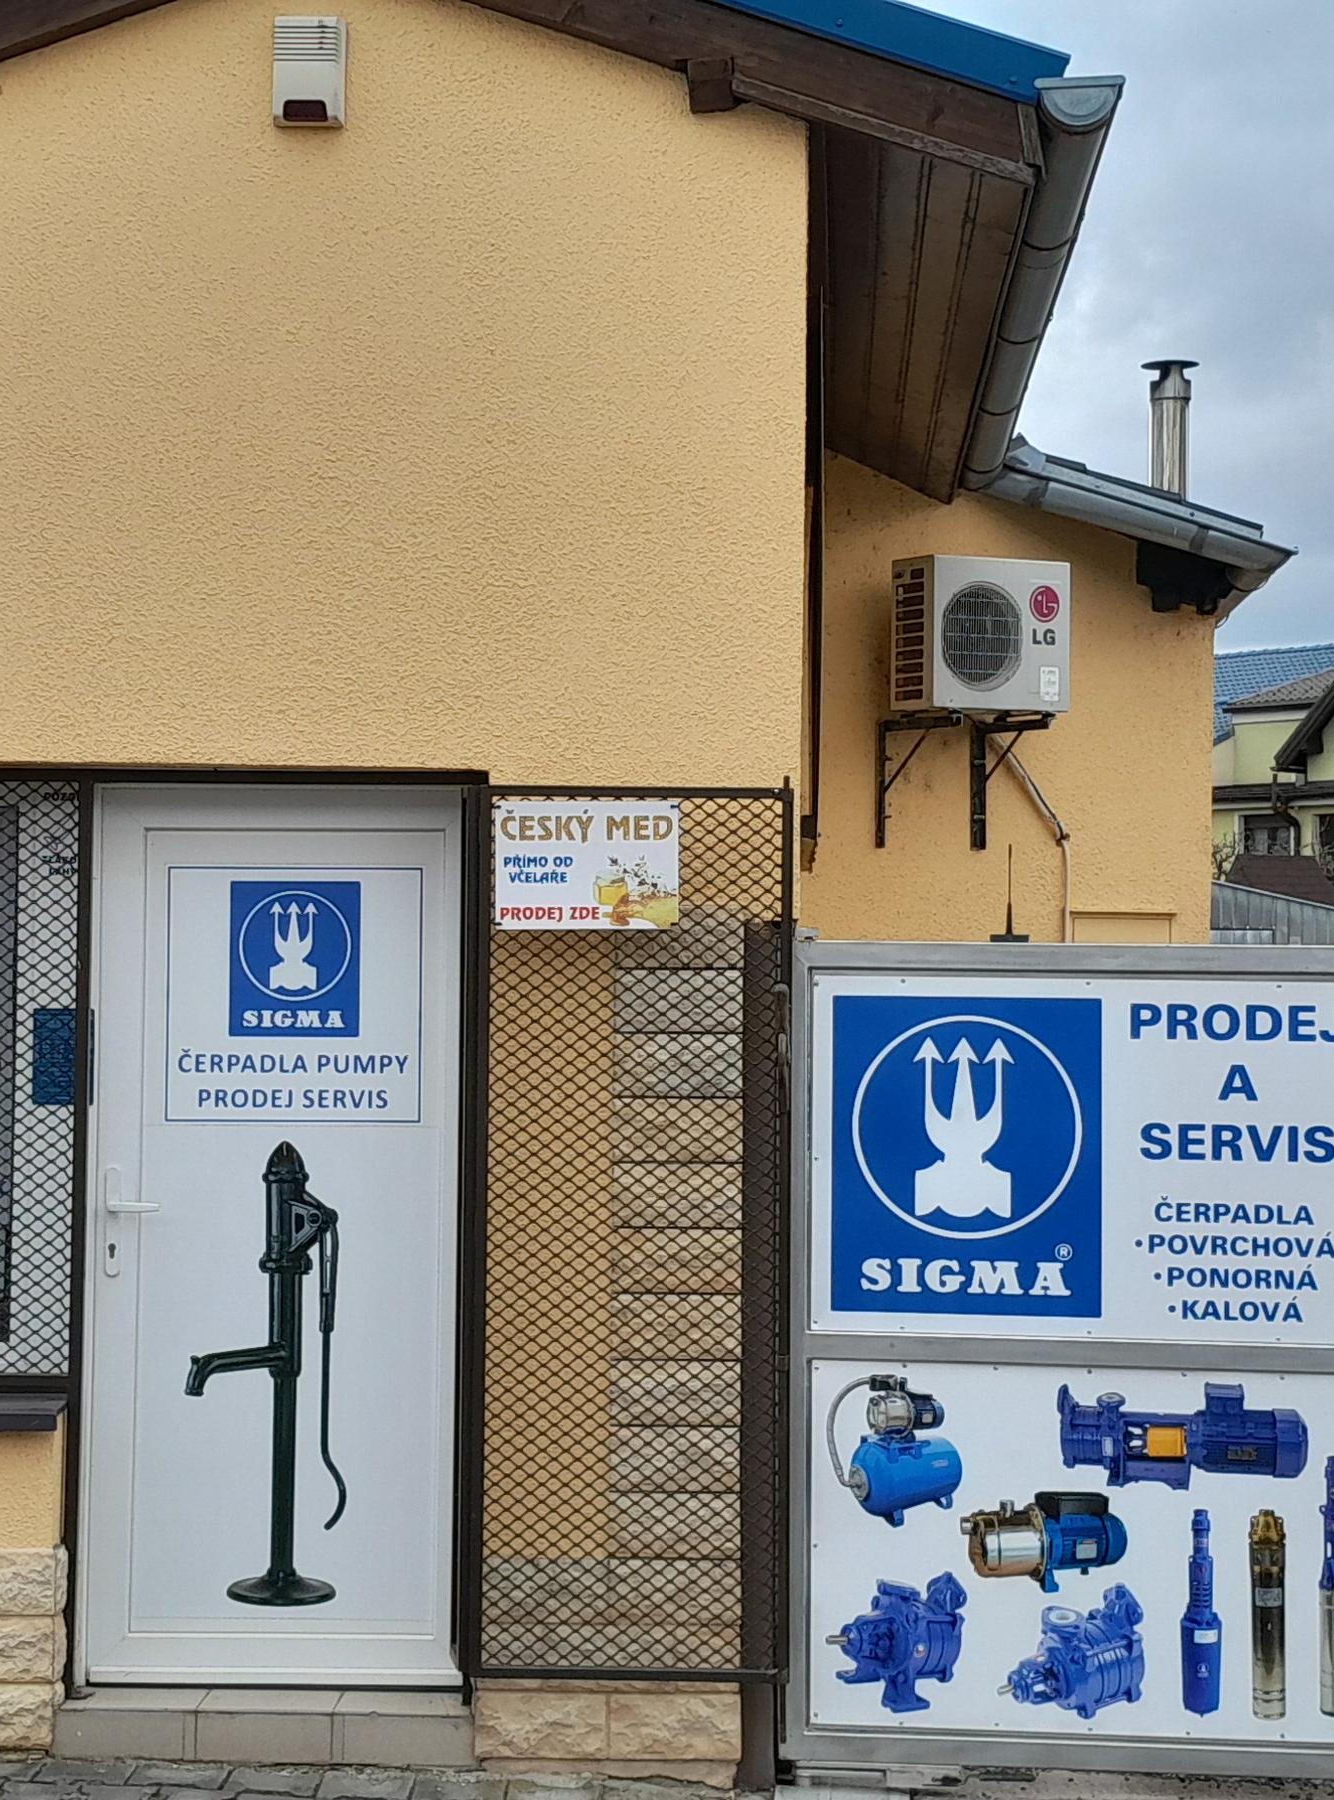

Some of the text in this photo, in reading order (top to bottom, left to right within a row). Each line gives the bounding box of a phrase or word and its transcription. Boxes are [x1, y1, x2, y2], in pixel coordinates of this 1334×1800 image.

[1032, 628, 1056, 645] LG
[500, 809, 673, 844] ČESKÝ MED
[503, 854, 573, 868] PŘÍMO OD
[508, 869, 568, 884] VČELAŘE
[499, 907, 600, 922] PRODEJ ZDE
[242, 1010, 346, 1028] SIGMA
[177, 1049, 409, 1075] ČERPADLA PUMPY
[1218, 1064, 1258, 1101] A
[198, 1089, 389, 1109] PRODEJ SERVIS
[1154, 1195, 1315, 1225] ČERPADLA
[860, 1257, 1072, 1297] SIGMA
